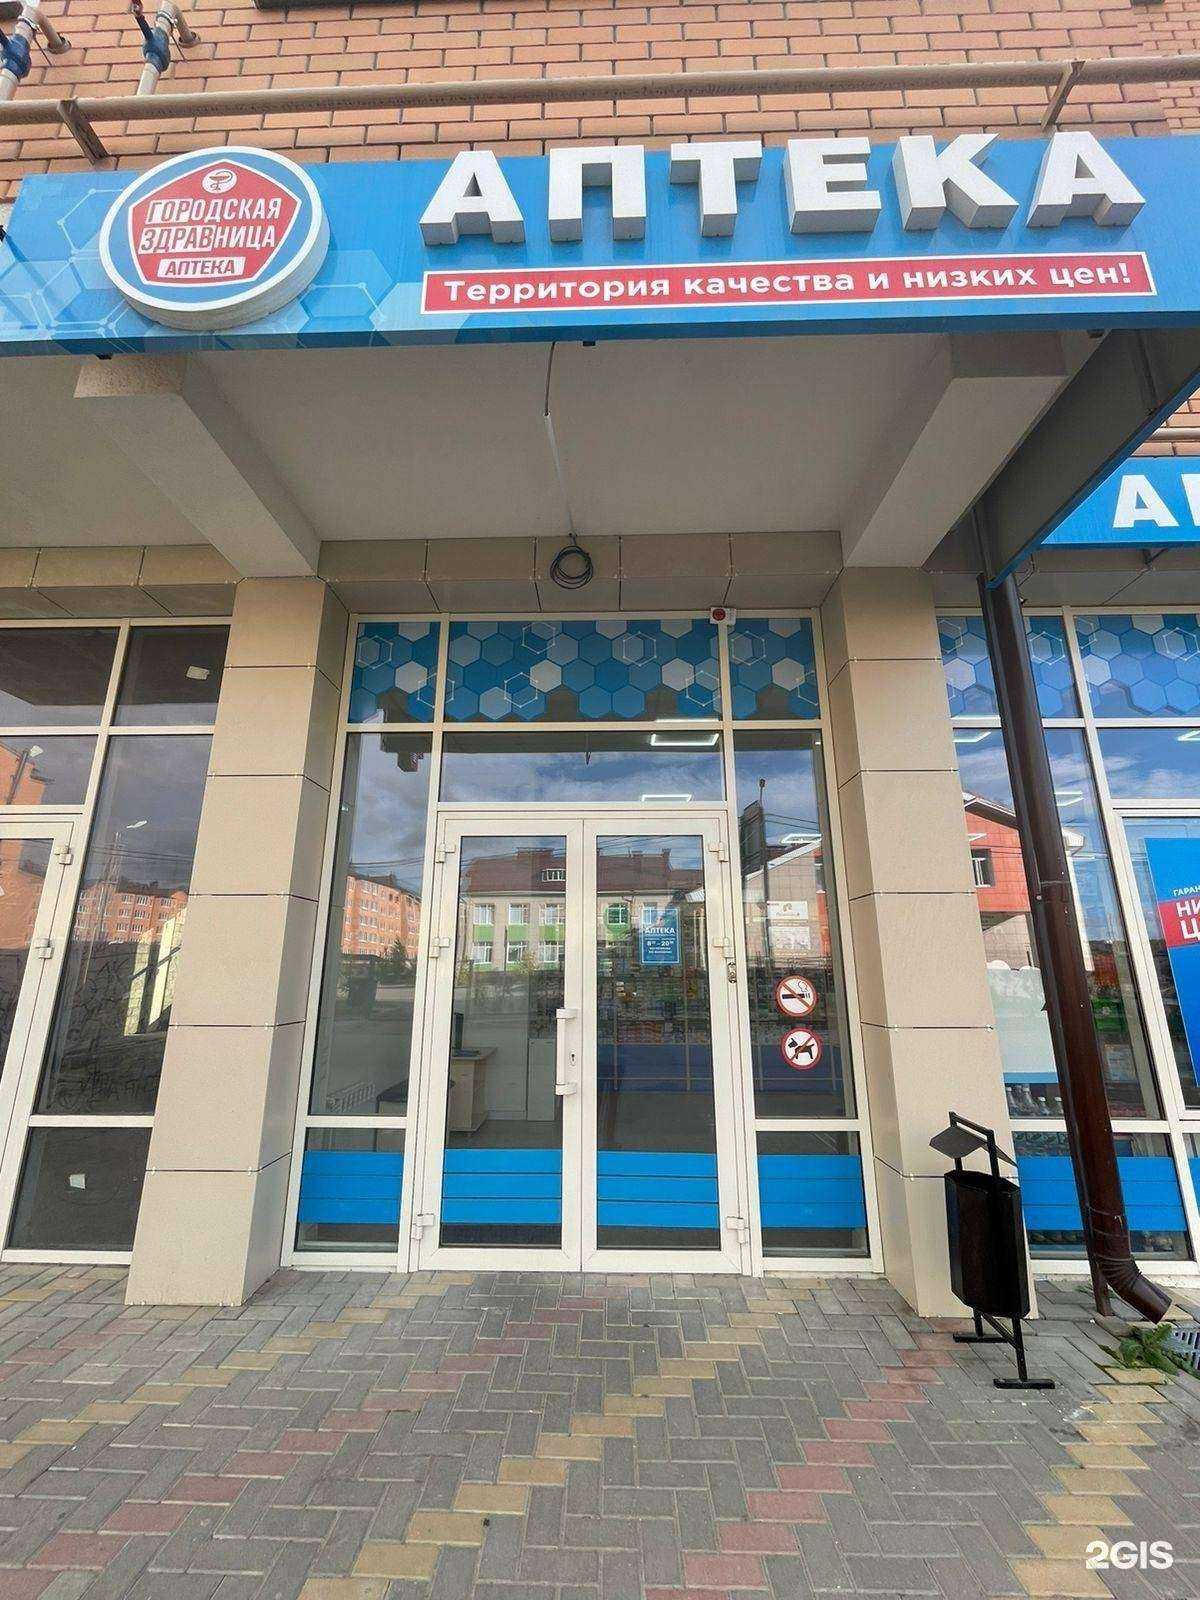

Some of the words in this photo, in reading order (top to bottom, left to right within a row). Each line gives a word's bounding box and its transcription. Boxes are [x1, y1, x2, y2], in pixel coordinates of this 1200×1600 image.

[419, 131, 1146, 245] АПТЕКА
[147, 197, 282, 224] ГОРОДСКАЯ
[139, 224, 276, 254] ЗДРАВНИЦА
[164, 258, 236, 276] АПТЕКА
[444, 277, 670, 305] Территория
[684, 273, 855, 296] качества
[868, 271, 890, 290] и
[902, 266, 1038, 289] низких
[1049, 262, 1132, 287] цен!
